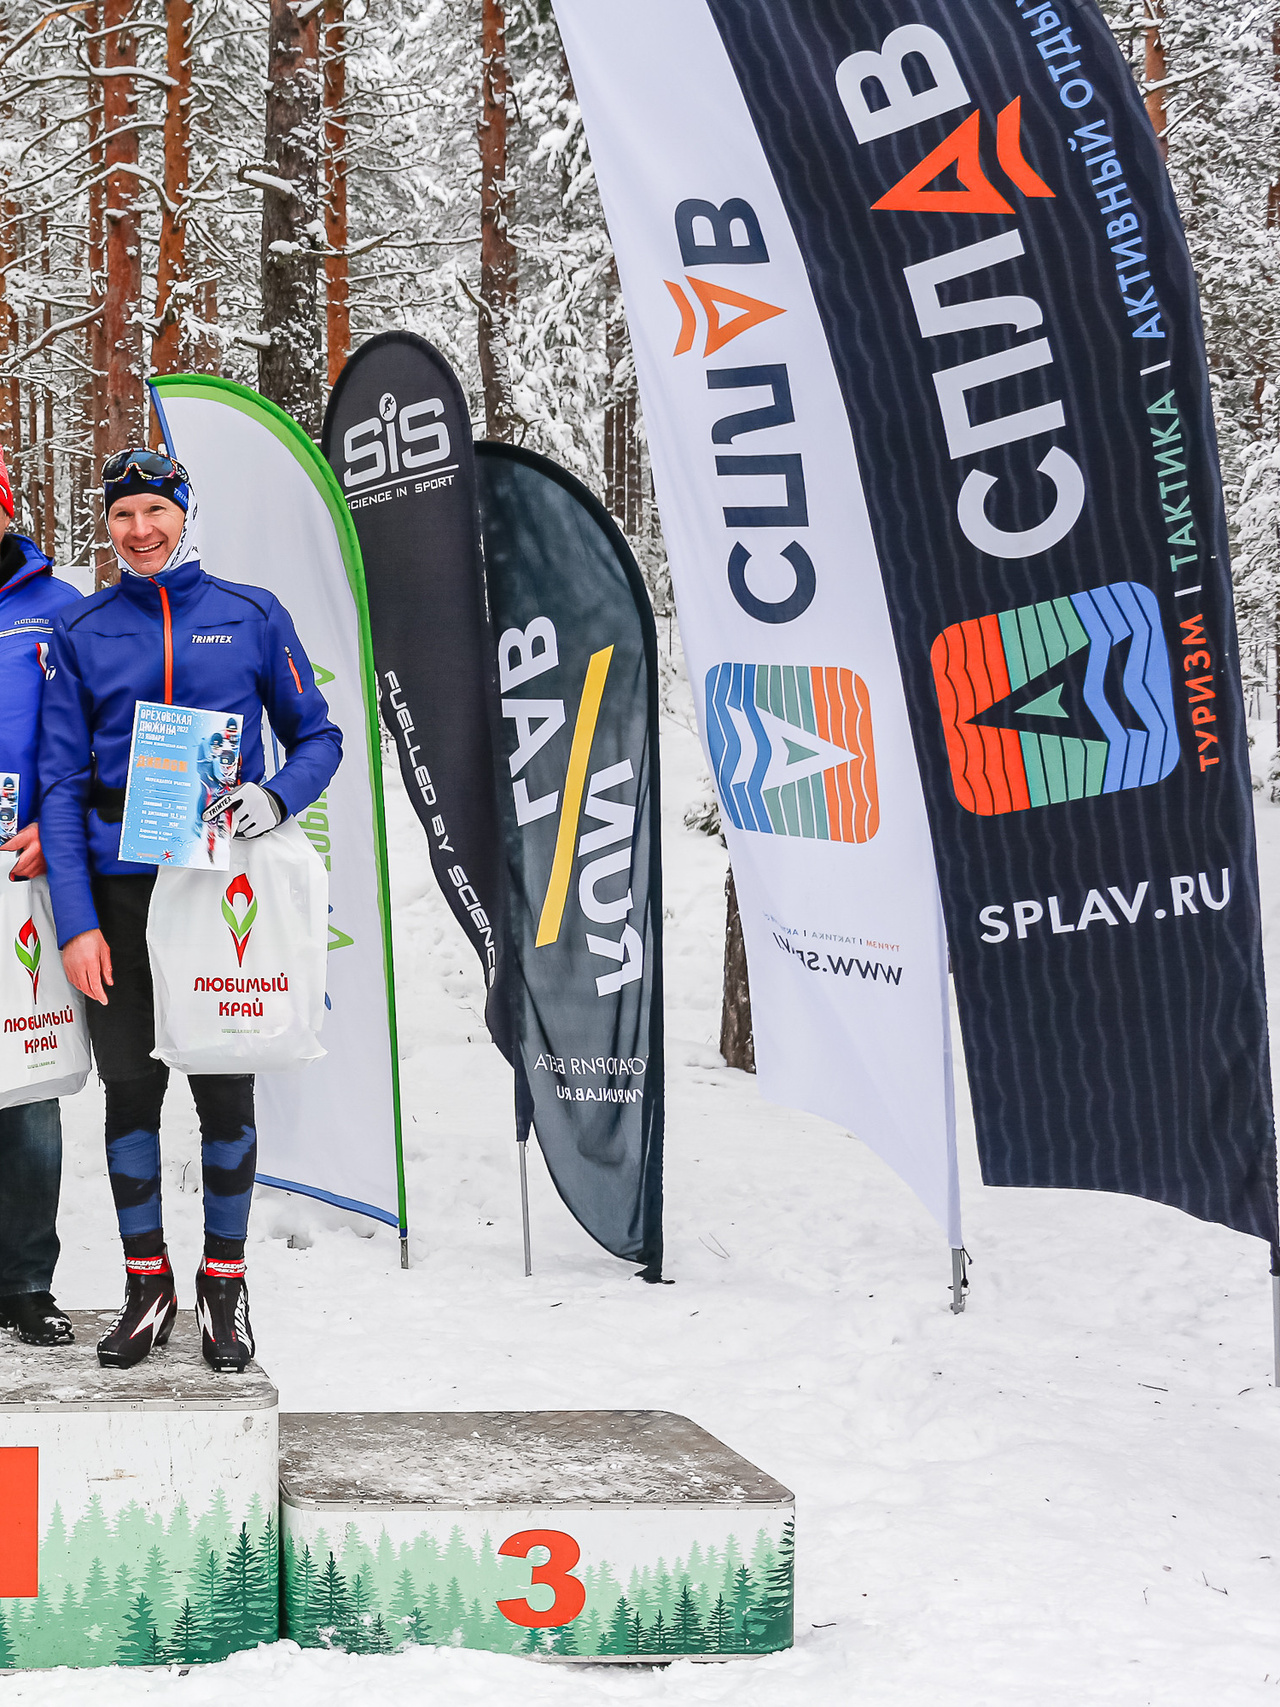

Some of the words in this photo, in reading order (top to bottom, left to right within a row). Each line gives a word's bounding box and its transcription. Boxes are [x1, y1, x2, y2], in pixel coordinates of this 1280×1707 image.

[1016, 0, 1094, 109] ОТДЫ
[1067, 119, 1166, 339] АКТИВНЫЙ
[835, 23, 1086, 559] СПЛАВ
[343, 392, 451, 488] SiS
[396, 486, 408, 498] IN
[414, 474, 455, 493] SPORT
[1147, 389, 1198, 572] ТАКТИКА
[173, 487, 189, 504] TRIM
[191, 633, 233, 645] TRIMTEX
[1180, 614, 1219, 772] ТУРИЗМ
[138, 720, 177, 736] ДЮЖИНА
[140, 708, 192, 726] ОРЕХОВСКАЯ
[136, 755, 188, 773] ДИПЛОМ
[384, 670, 437, 806] FUELLED
[431, 814, 455, 853] BY
[209, 796, 233, 817] TRIMTEX
[977, 868, 1231, 945] SPLAV.RU
[193, 972, 289, 993] ЛЮБИМЫЙ
[3, 1005, 74, 1034] ЛЮБИМЫЙ
[218, 997, 264, 1017] КРАЙ
[24, 1031, 58, 1054] КРАЙ
[494, 1529, 587, 1630] 3
